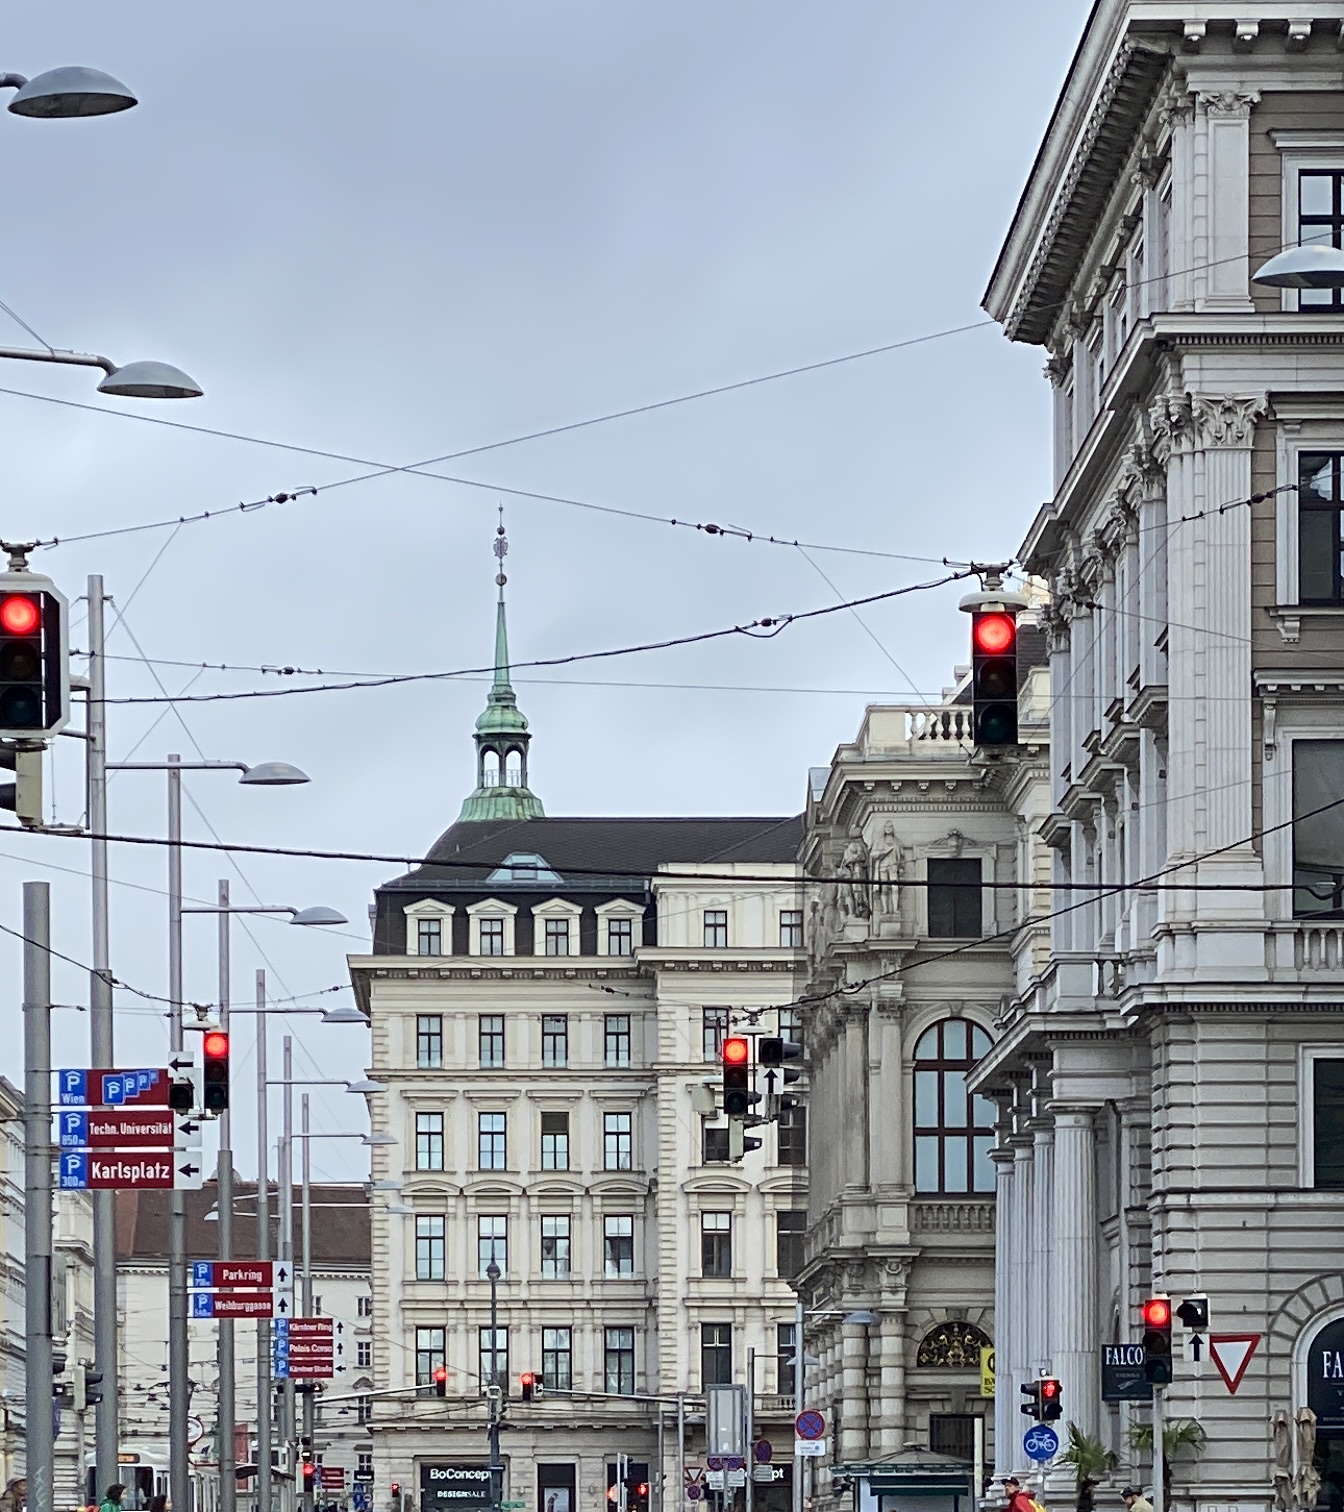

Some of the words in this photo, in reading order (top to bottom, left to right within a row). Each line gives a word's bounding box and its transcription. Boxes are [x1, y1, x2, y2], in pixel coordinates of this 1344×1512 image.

[61, 1092, 85, 1104] Wien
[89, 1122, 119, 1135] Techn.
[120, 1121, 172, 1135] Universität
[91, 1161, 170, 1183] Karlsplatz
[222, 1269, 263, 1283] Parkring
[1105, 1346, 1144, 1365] FALCO
